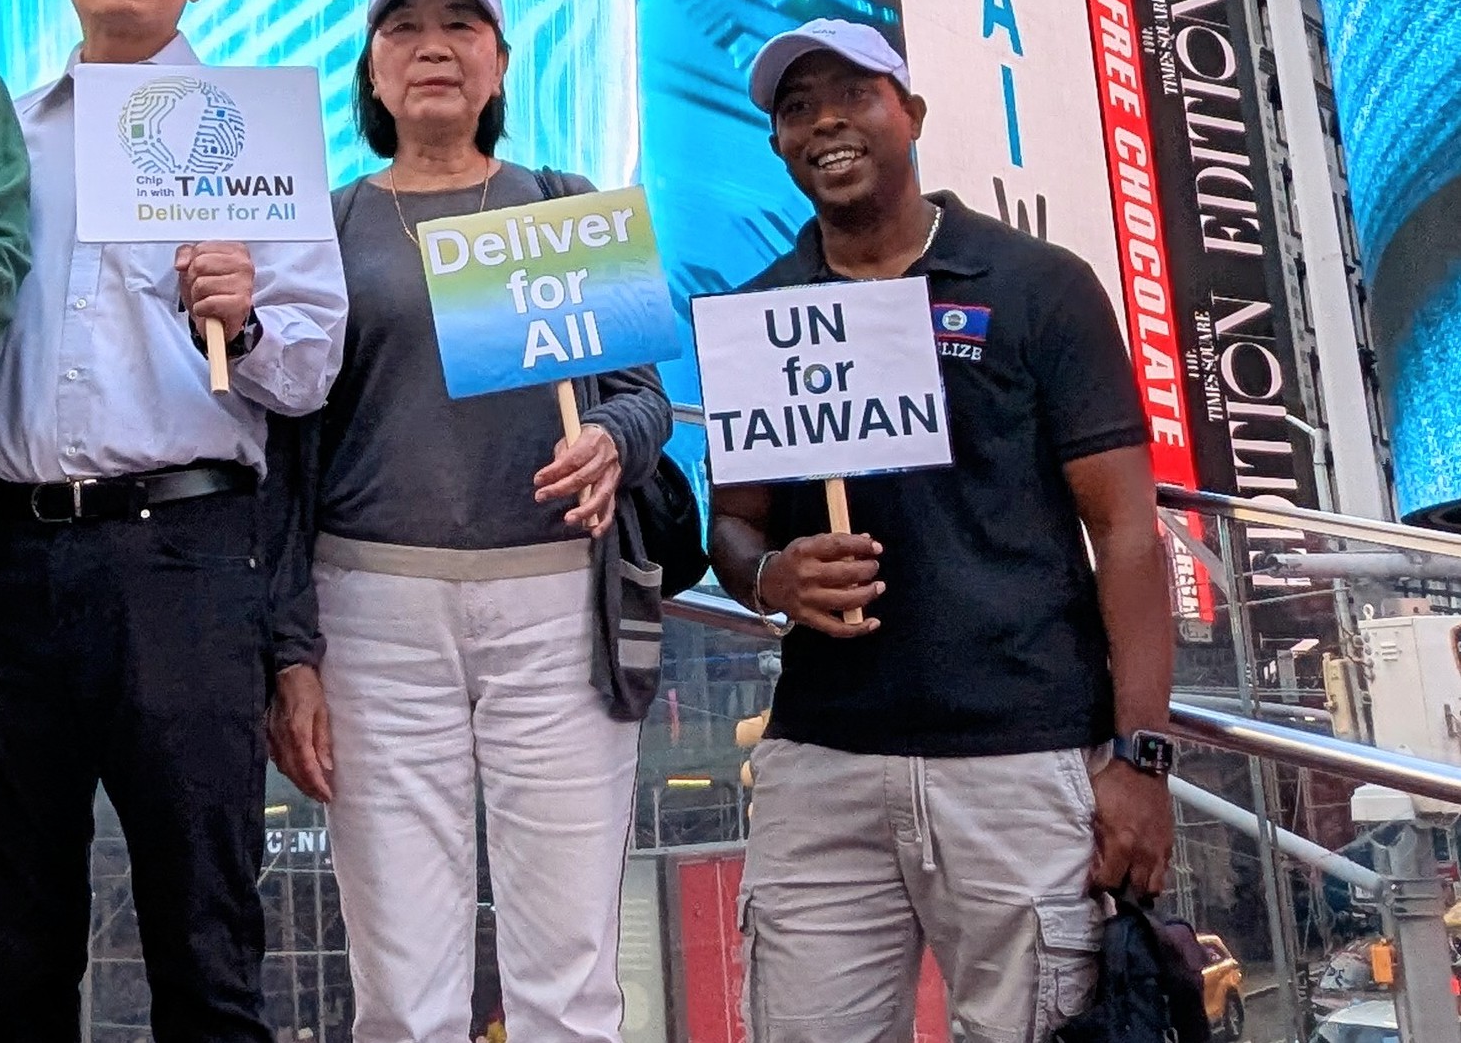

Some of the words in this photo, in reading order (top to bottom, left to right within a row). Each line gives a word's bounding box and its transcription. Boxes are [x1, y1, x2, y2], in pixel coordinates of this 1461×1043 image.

[1159, 50, 1179, 96] TIMES
[136, 175, 163, 187] Chip
[151, 188, 175, 197] with
[174, 175, 294, 197] TAIWAN
[138, 204, 220, 221] Deliver
[227, 203, 260, 221] for
[266, 202, 296, 220] All
[425, 206, 634, 276] Deliver
[506, 267, 589, 315] for
[1114, 126, 1185, 449] CHOCOLATE
[521, 310, 604, 369] All
[764, 302, 848, 349] UN
[1194, 311, 1219, 373] SQUARE
[782, 356, 855, 397] for
[1202, 373, 1225, 422] TIMES
[709, 393, 939, 453] TAIWAN
